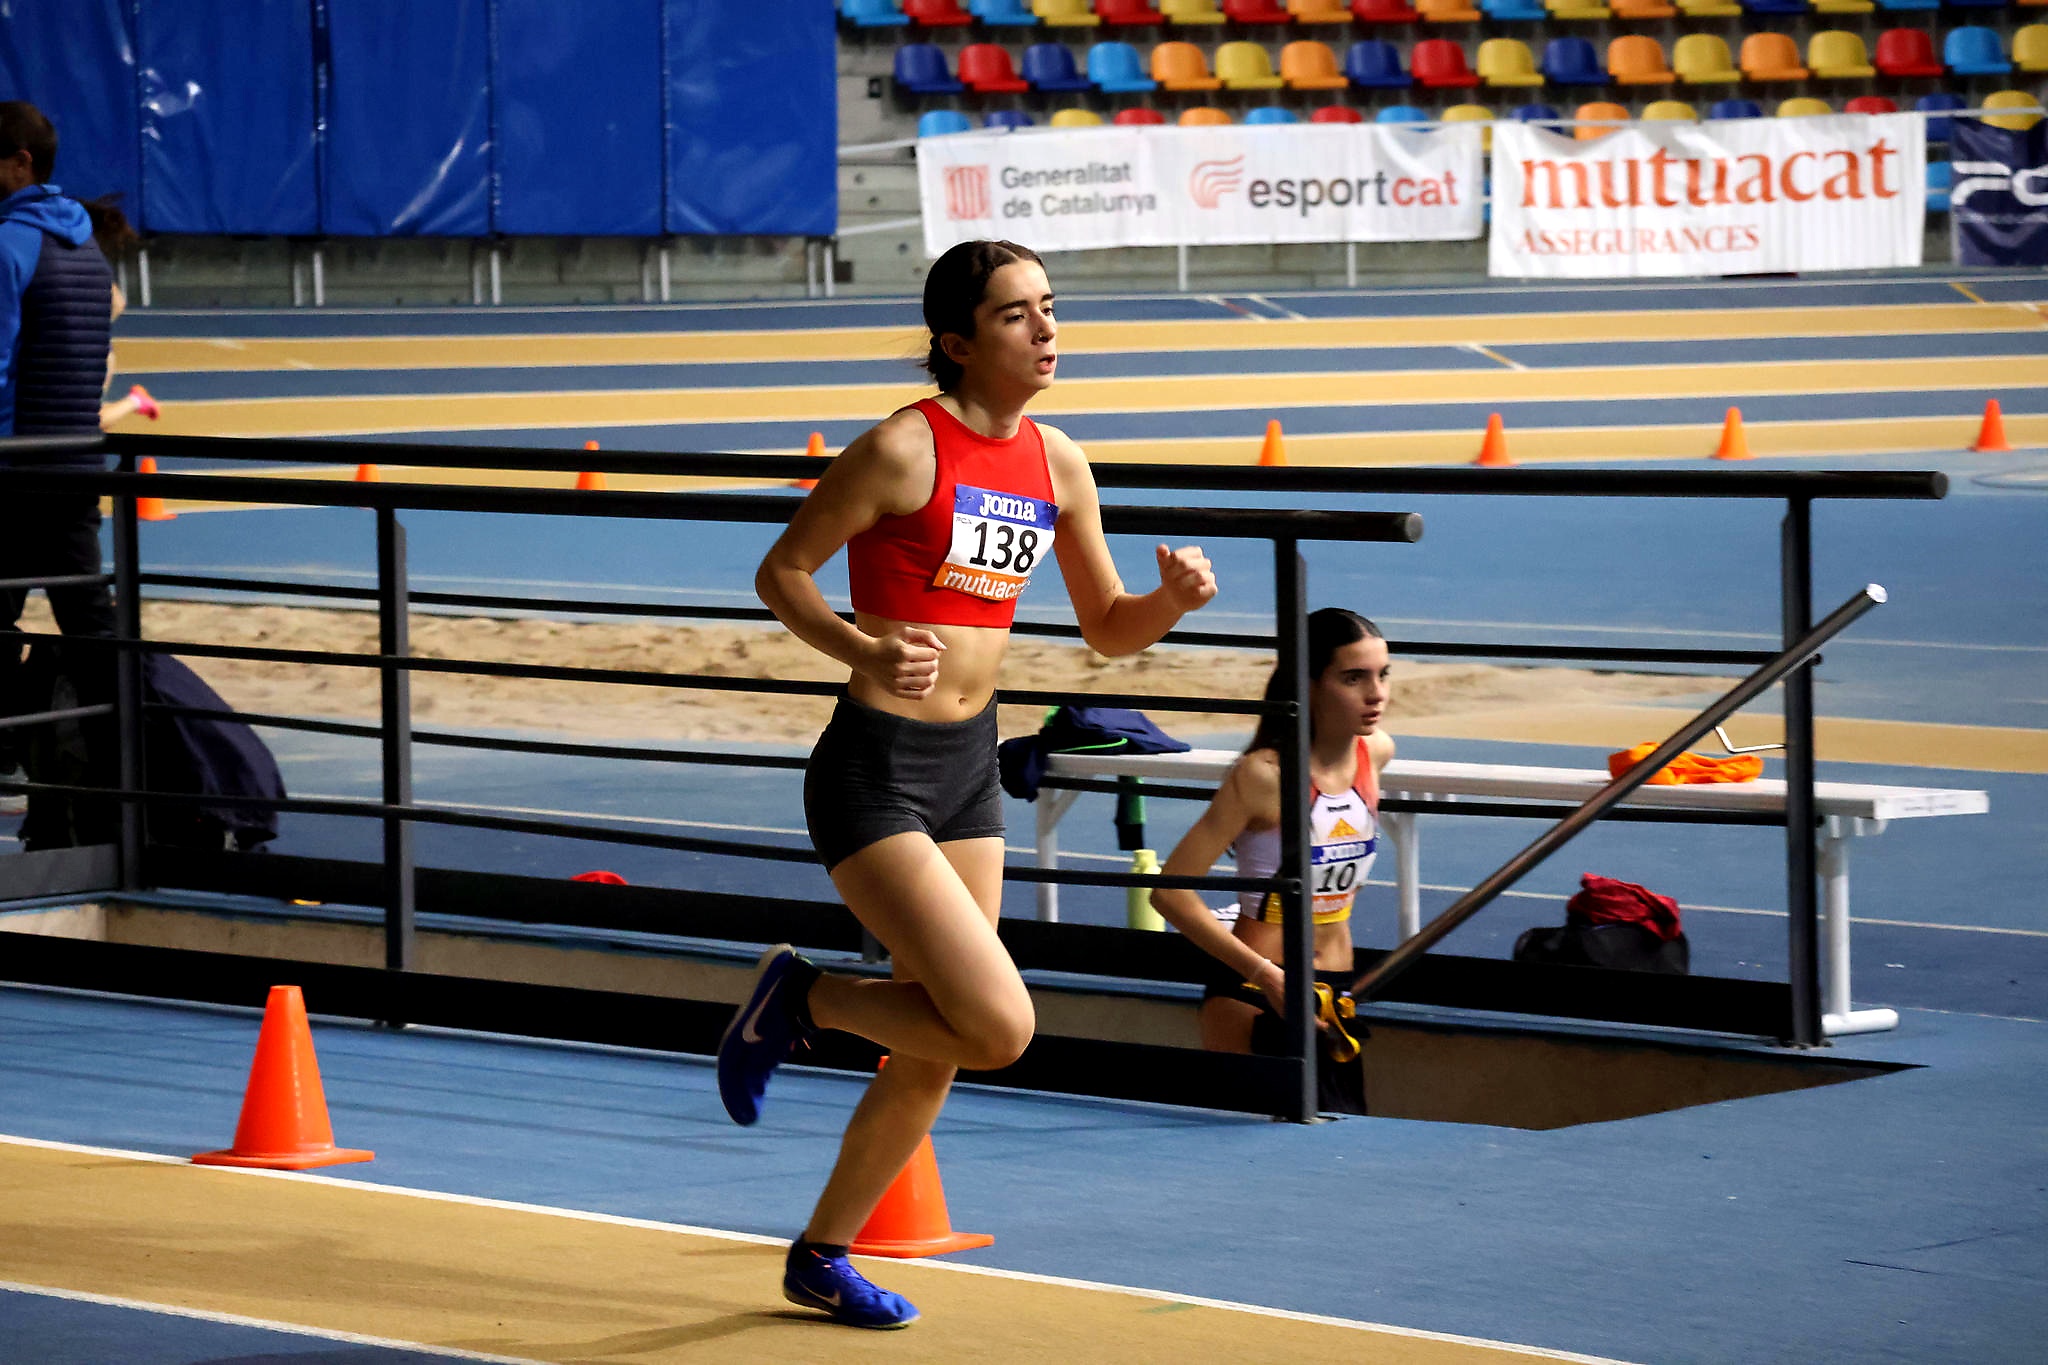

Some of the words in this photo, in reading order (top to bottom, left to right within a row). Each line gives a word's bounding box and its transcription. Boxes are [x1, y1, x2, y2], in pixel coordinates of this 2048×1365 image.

[1001, 162, 1131, 189] Generalitat
[1519, 136, 1900, 209] mutuacat
[1003, 198, 1032, 219] de
[1040, 192, 1156, 217] Catalunya
[1249, 170, 1459, 217] esportcat
[1519, 225, 1760, 255] ASSEGURANCES
[969, 521, 1038, 573] 138
[943, 570, 1030, 599] mutuac
